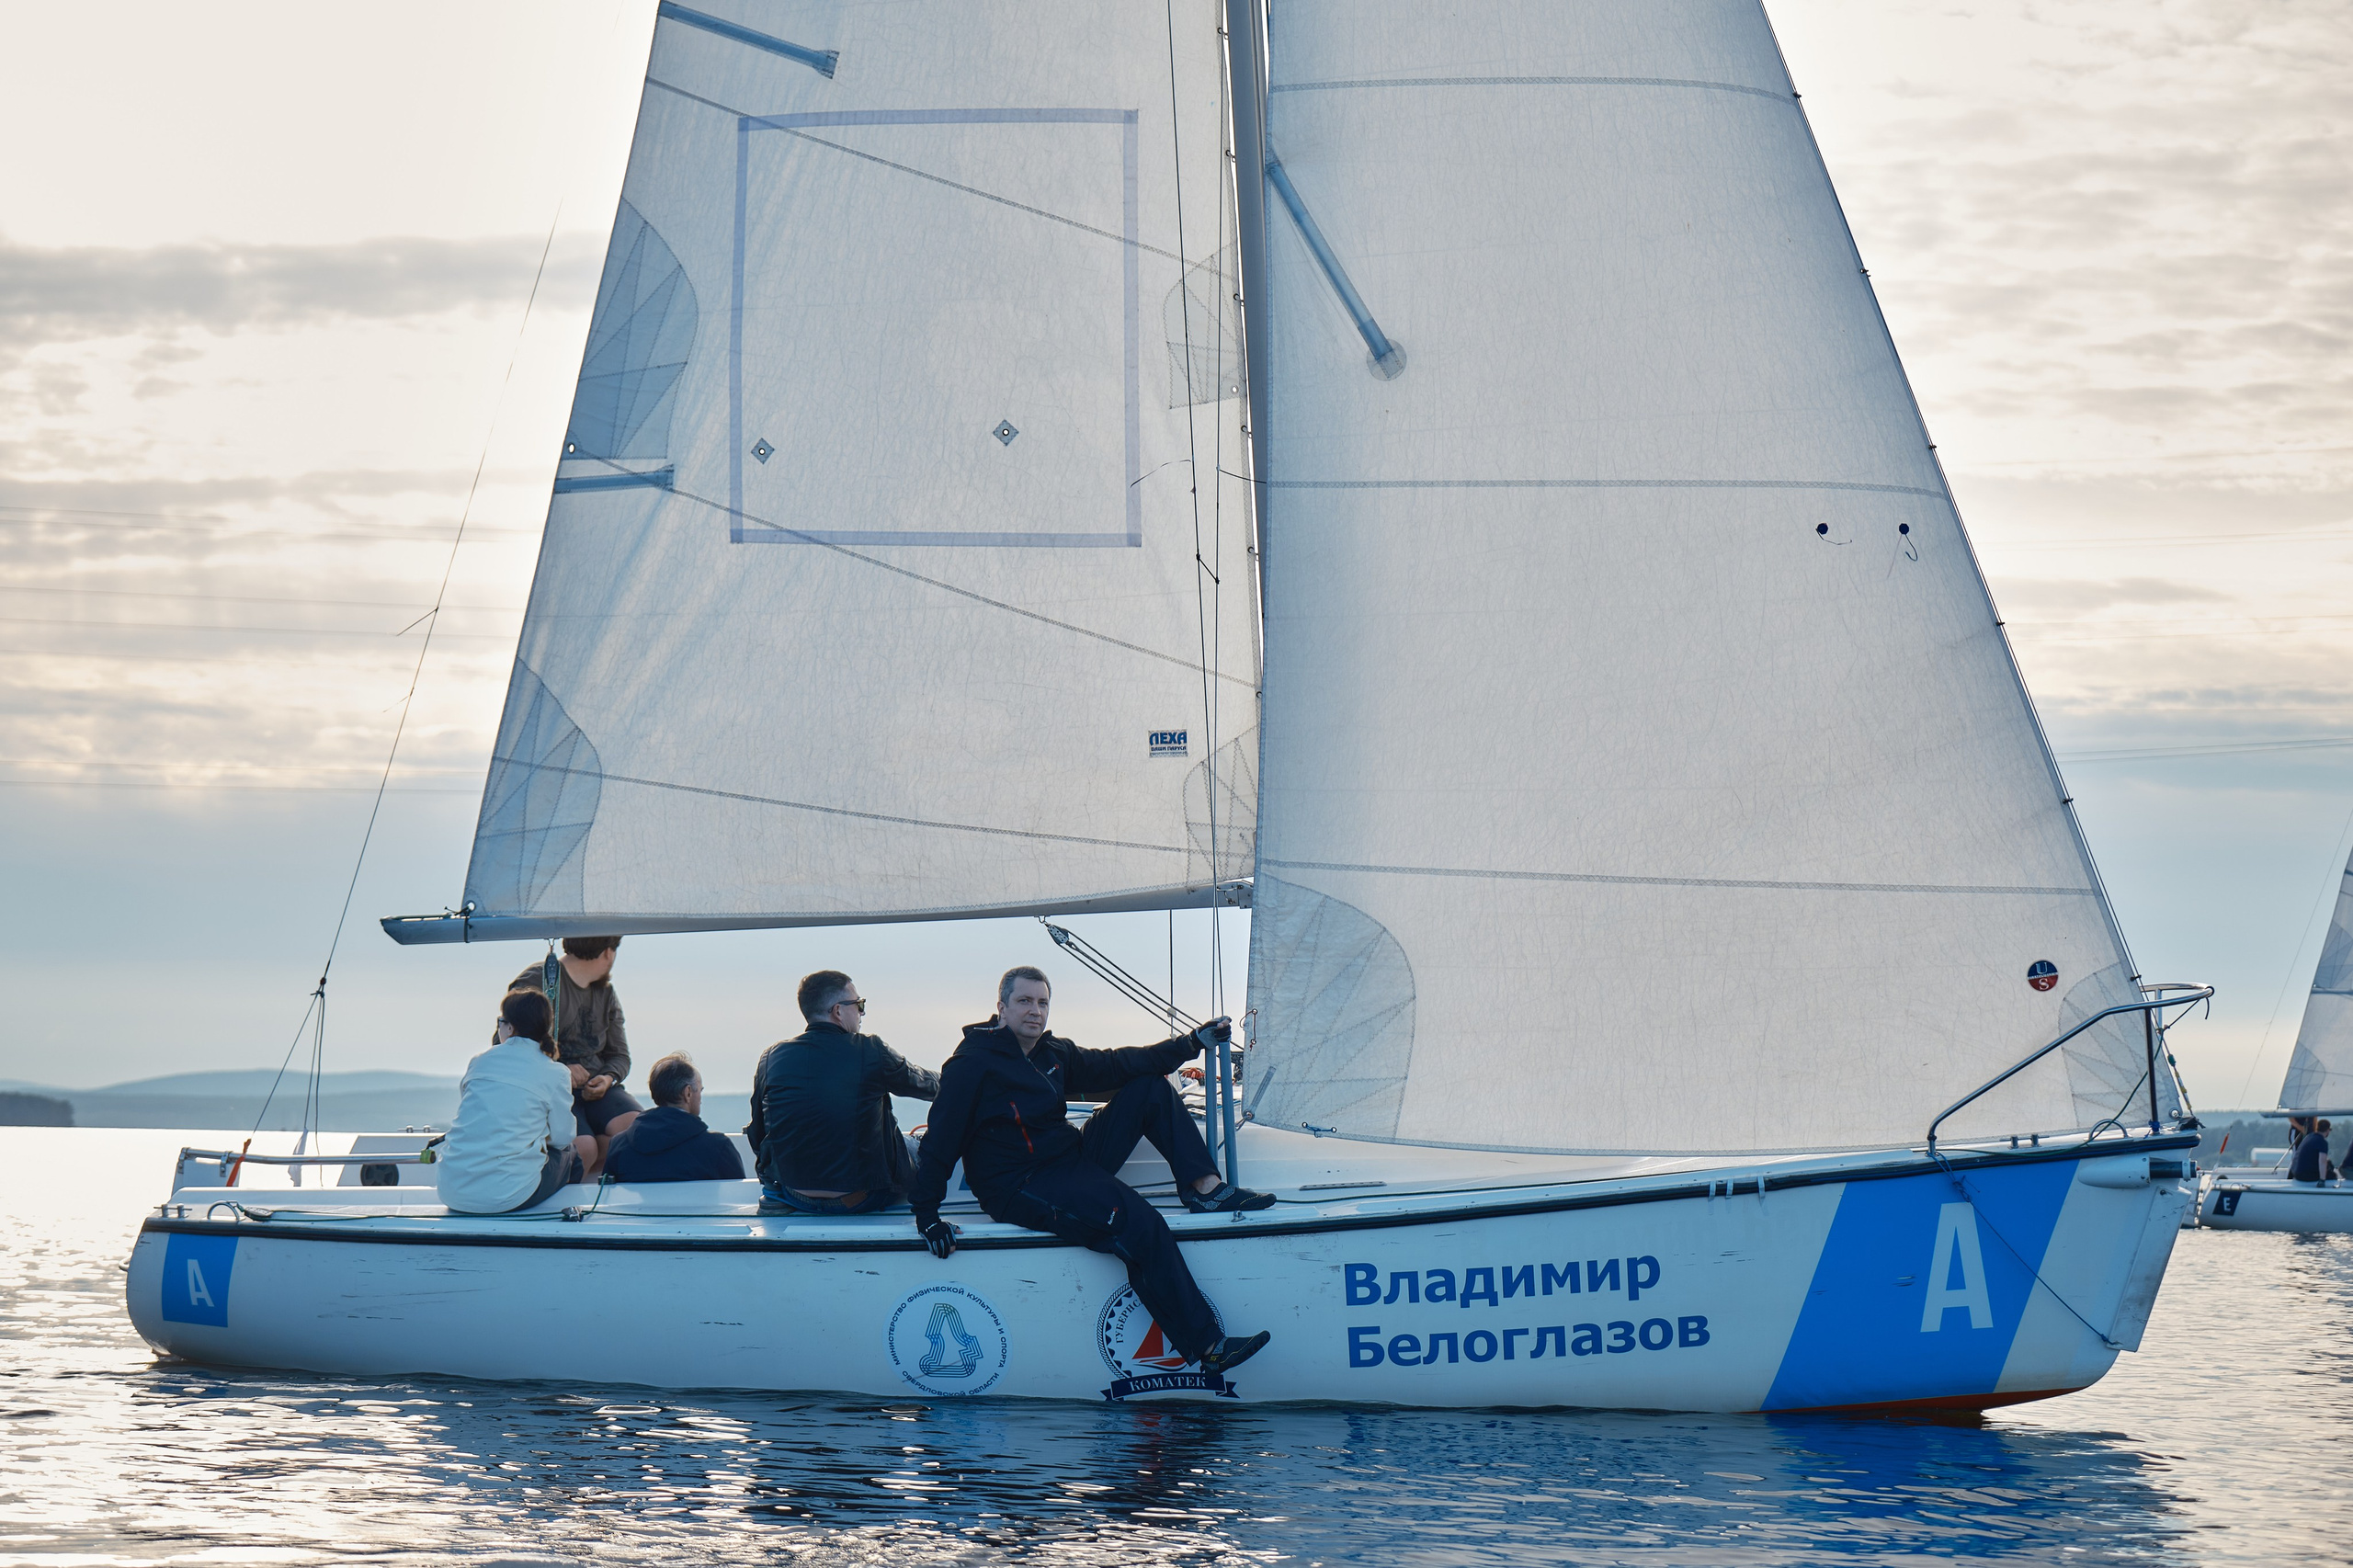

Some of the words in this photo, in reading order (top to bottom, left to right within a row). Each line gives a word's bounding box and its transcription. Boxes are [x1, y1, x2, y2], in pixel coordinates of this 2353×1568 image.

[1149, 732, 1187, 745] ЛЕХА
[1344, 1254, 1661, 1309] Владимир
[888, 1302, 907, 1366] МИНИСТЕРСТВО
[906, 1286, 965, 1303] ФИЗИЧЕСКОЙ
[966, 1291, 1001, 1326] КУЛЬТУРЫ
[998, 1336, 1007, 1368] СПОРТА
[1115, 1299, 1142, 1344] ГУБЕРНС
[1347, 1314, 1711, 1369] Белоглазов
[902, 1370, 966, 1396] СВЕРДЛОВСКОЙ
[968, 1372, 1000, 1395] ОБЛАСТИ
[1129, 1377, 1207, 1392] КОМАТЕК
